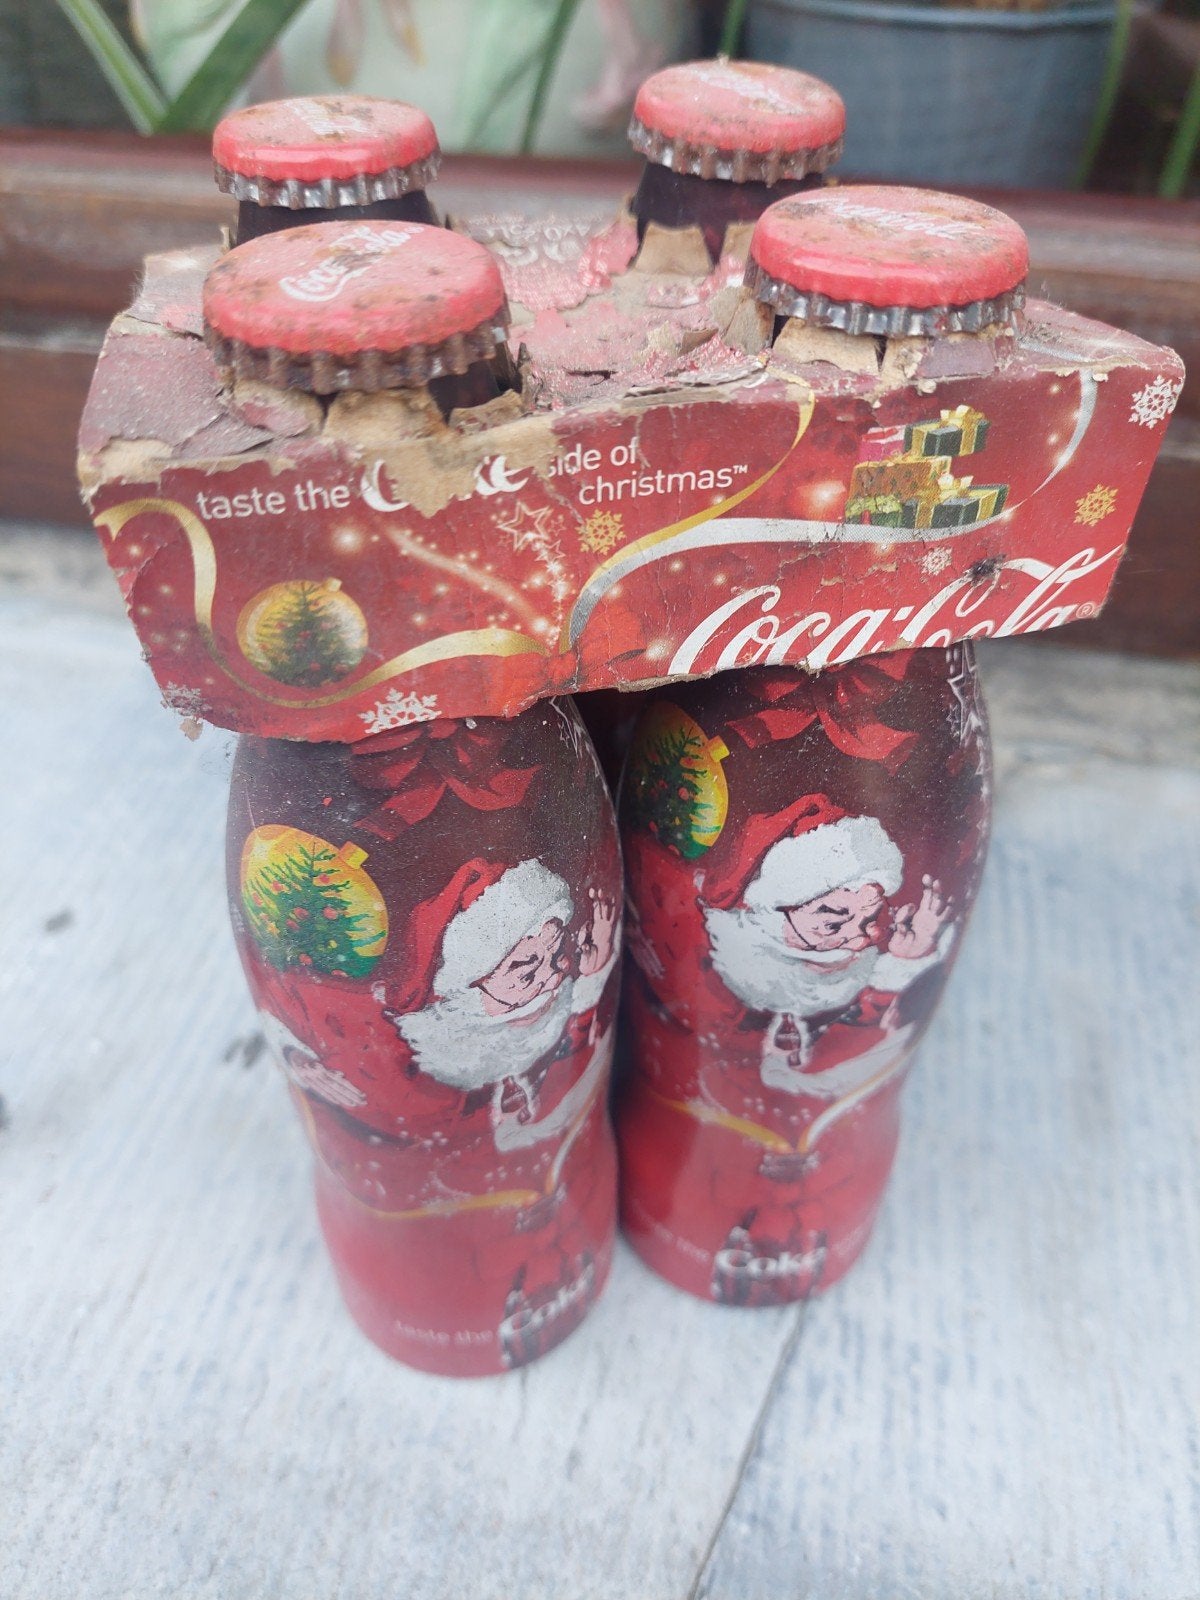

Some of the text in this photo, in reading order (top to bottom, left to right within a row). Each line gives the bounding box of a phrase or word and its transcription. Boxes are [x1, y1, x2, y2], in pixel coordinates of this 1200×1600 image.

[196, 488, 287, 521] taste
[294, 480, 351, 513] the
[361, 454, 535, 513] Ce
[610, 436, 641, 467] of
[714, 1245, 829, 1276] Coke
[498, 1262, 595, 1338] Coke
